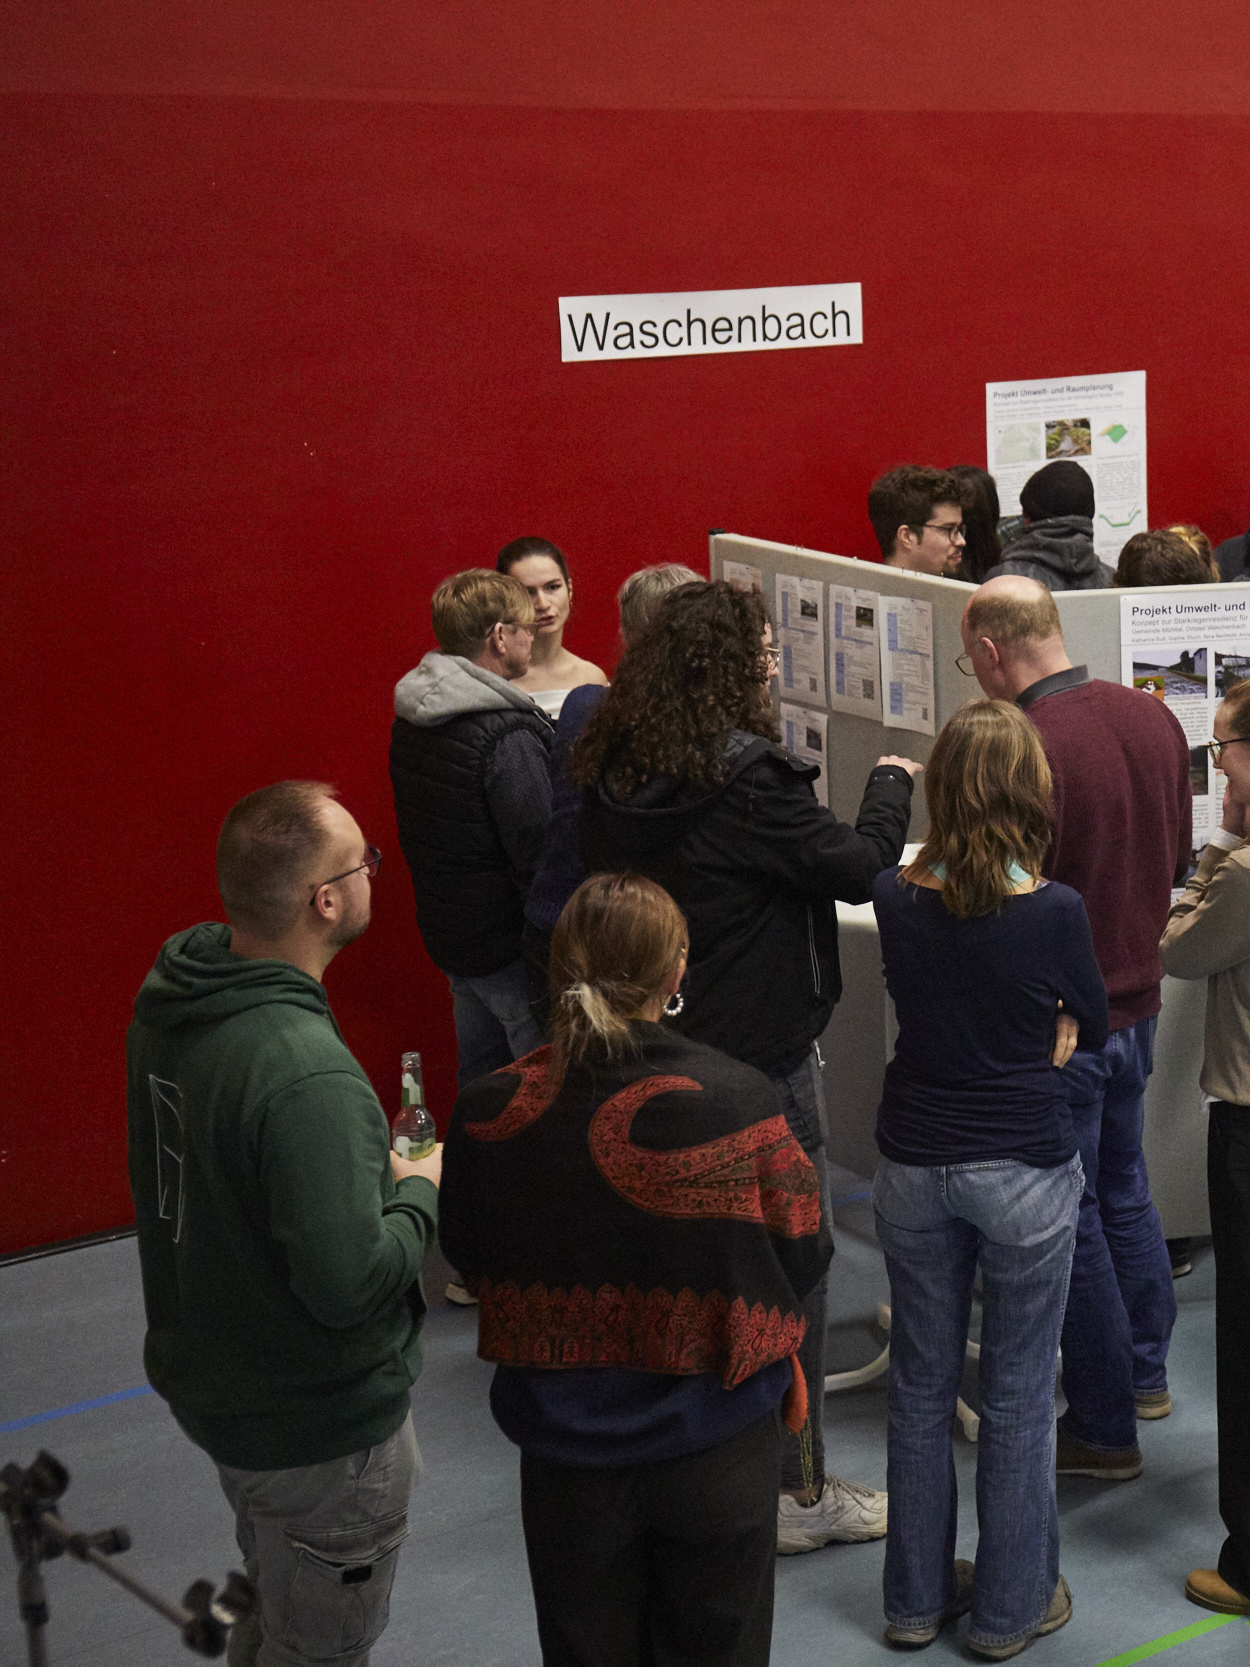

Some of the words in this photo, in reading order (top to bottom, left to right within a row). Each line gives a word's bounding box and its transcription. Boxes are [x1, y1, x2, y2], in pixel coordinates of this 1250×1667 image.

[566, 300, 851, 353] Waschenbach
[993, 390, 1019, 400] Projekt
[1020, 387, 1050, 398] Umwelt-
[1050, 386, 1064, 395] und
[1066, 383, 1114, 393] Raumplanung
[1132, 606, 1172, 618] Projekt
[1175, 603, 1221, 614] Umwelt-
[1224, 601, 1246, 612] und
[1131, 619, 1160, 628] Konzept
[1174, 615, 1238, 625] Starkregenresilienz
